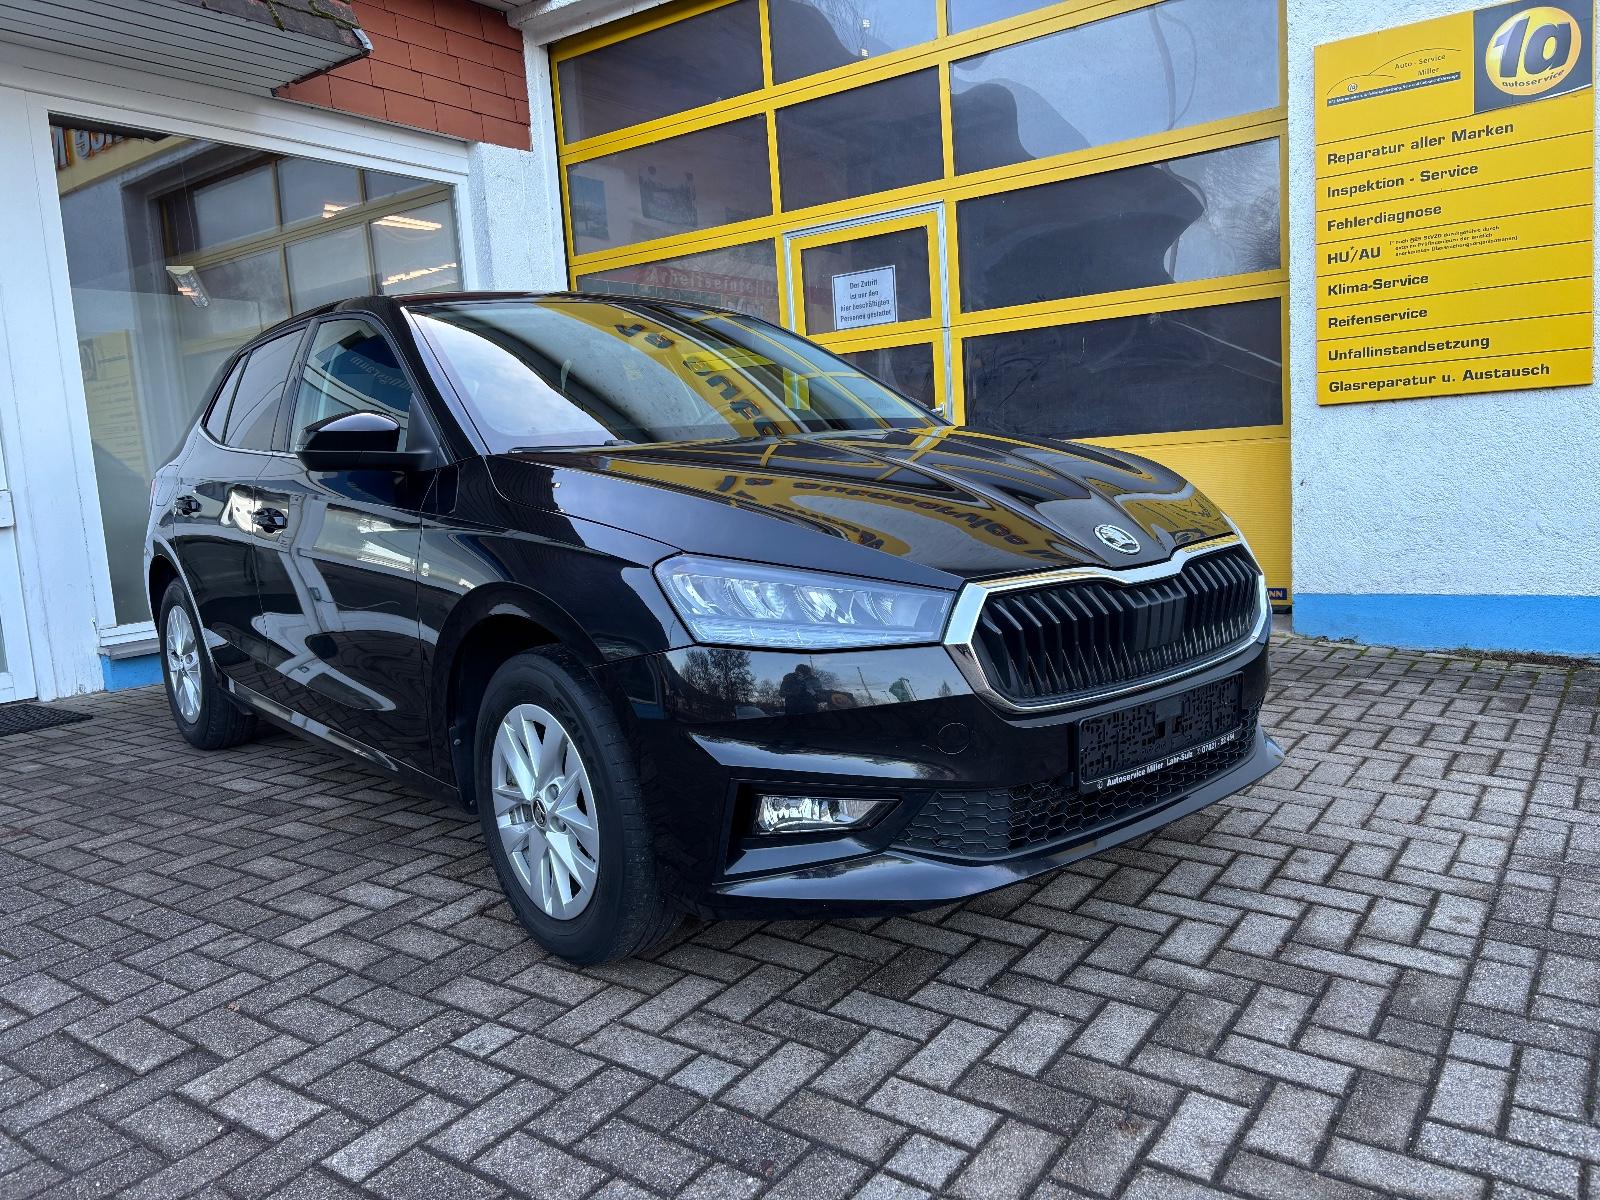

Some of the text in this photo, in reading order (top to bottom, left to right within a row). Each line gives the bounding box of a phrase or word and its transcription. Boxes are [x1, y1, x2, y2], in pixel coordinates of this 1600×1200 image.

[1394, 62, 1413, 70] Auto
[1418, 54, 1446, 65] Service
[1417, 67, 1440, 76] Miller
[1501, 69, 1565, 88] autoservice
[1327, 122, 1514, 165] Reparatur aller Marken
[1327, 176, 1405, 198] Inspektion
[1420, 164, 1479, 182] Service
[1327, 205, 1442, 232] Fehlerdiagnose
[860, 278, 878, 288] Zutritt
[868, 289, 879, 298] den
[1327, 274, 1429, 297] Klima-Service
[840, 305, 852, 313] hier
[840, 309, 892, 323] Personen gestattet
[1327, 307, 1428, 329] Reifenservice
[1327, 336, 1490, 361] Unfallinstandsetzung
[1328, 363, 1550, 394] Glasreparatur u. Austausch
[1106, 769, 1146, 787] Autoservice
[1146, 762, 1164, 773] Miller
